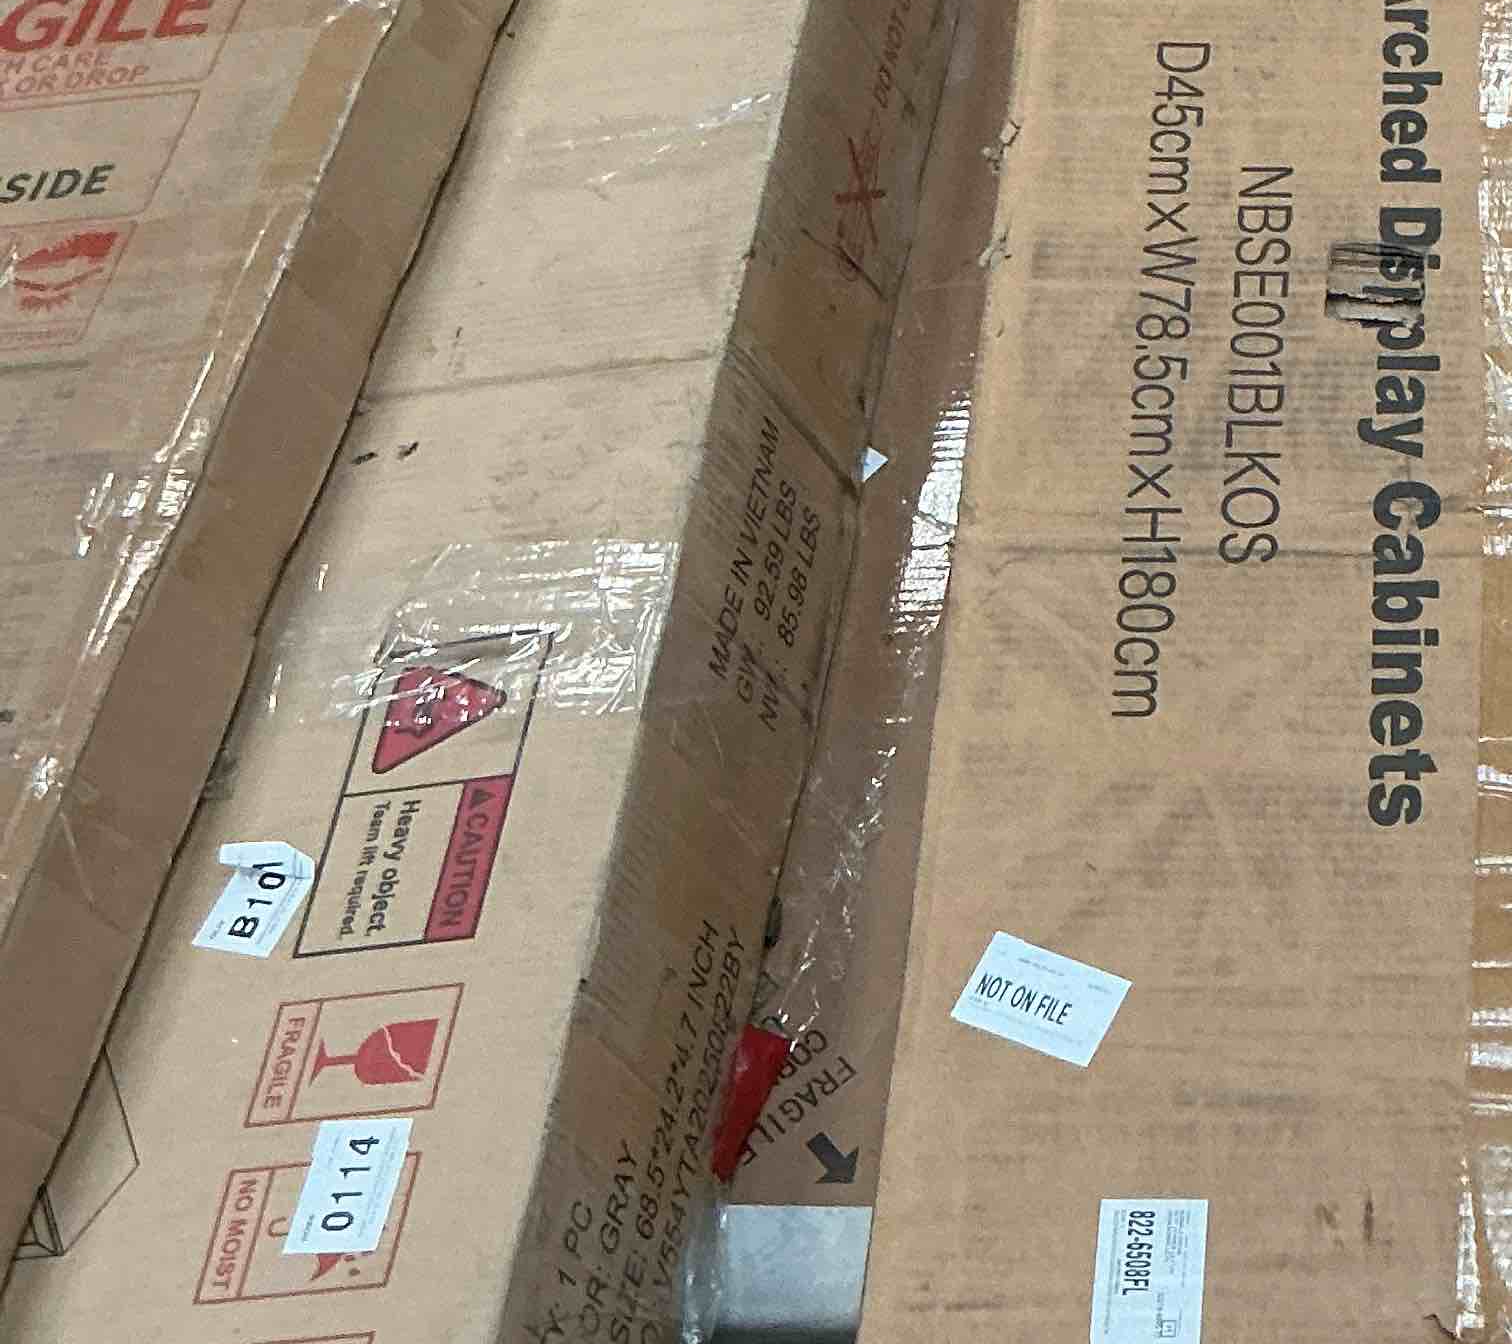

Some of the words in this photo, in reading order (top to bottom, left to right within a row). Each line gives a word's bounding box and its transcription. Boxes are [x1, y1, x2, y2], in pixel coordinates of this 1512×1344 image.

[1357, 206, 1443, 460] Display
[739, 415, 781, 549] VIETNAM
[730, 546, 753, 588] IN
[754, 540, 785, 622] 92.59
[772, 479, 798, 543] LBS
[776, 566, 809, 649] 85.98
[796, 509, 822, 571] LBS
[708, 584, 744, 681] MADE
[1366, 480, 1443, 830] Cabinets
[358, 845, 380, 867] lift
[366, 799, 392, 863] Team
[382, 799, 423, 862] Heavy
[439, 812, 490, 928] CAUTION
[686, 918, 719, 1008] INCH
[974, 973, 1013, 1003] NOT
[1010, 986, 1038, 1014] ON
[1033, 994, 1073, 1026] FILE
[263, 1016, 306, 1110] FRAGILE
[235, 1179, 258, 1213] NO
[320, 1134, 381, 1233] 0114
[564, 1199, 594, 1258] PC
[600, 1139, 639, 1257] GRAY
[211, 1218, 248, 1290] MOIST
[1121, 1209, 1156, 1297] 822-6508FL
